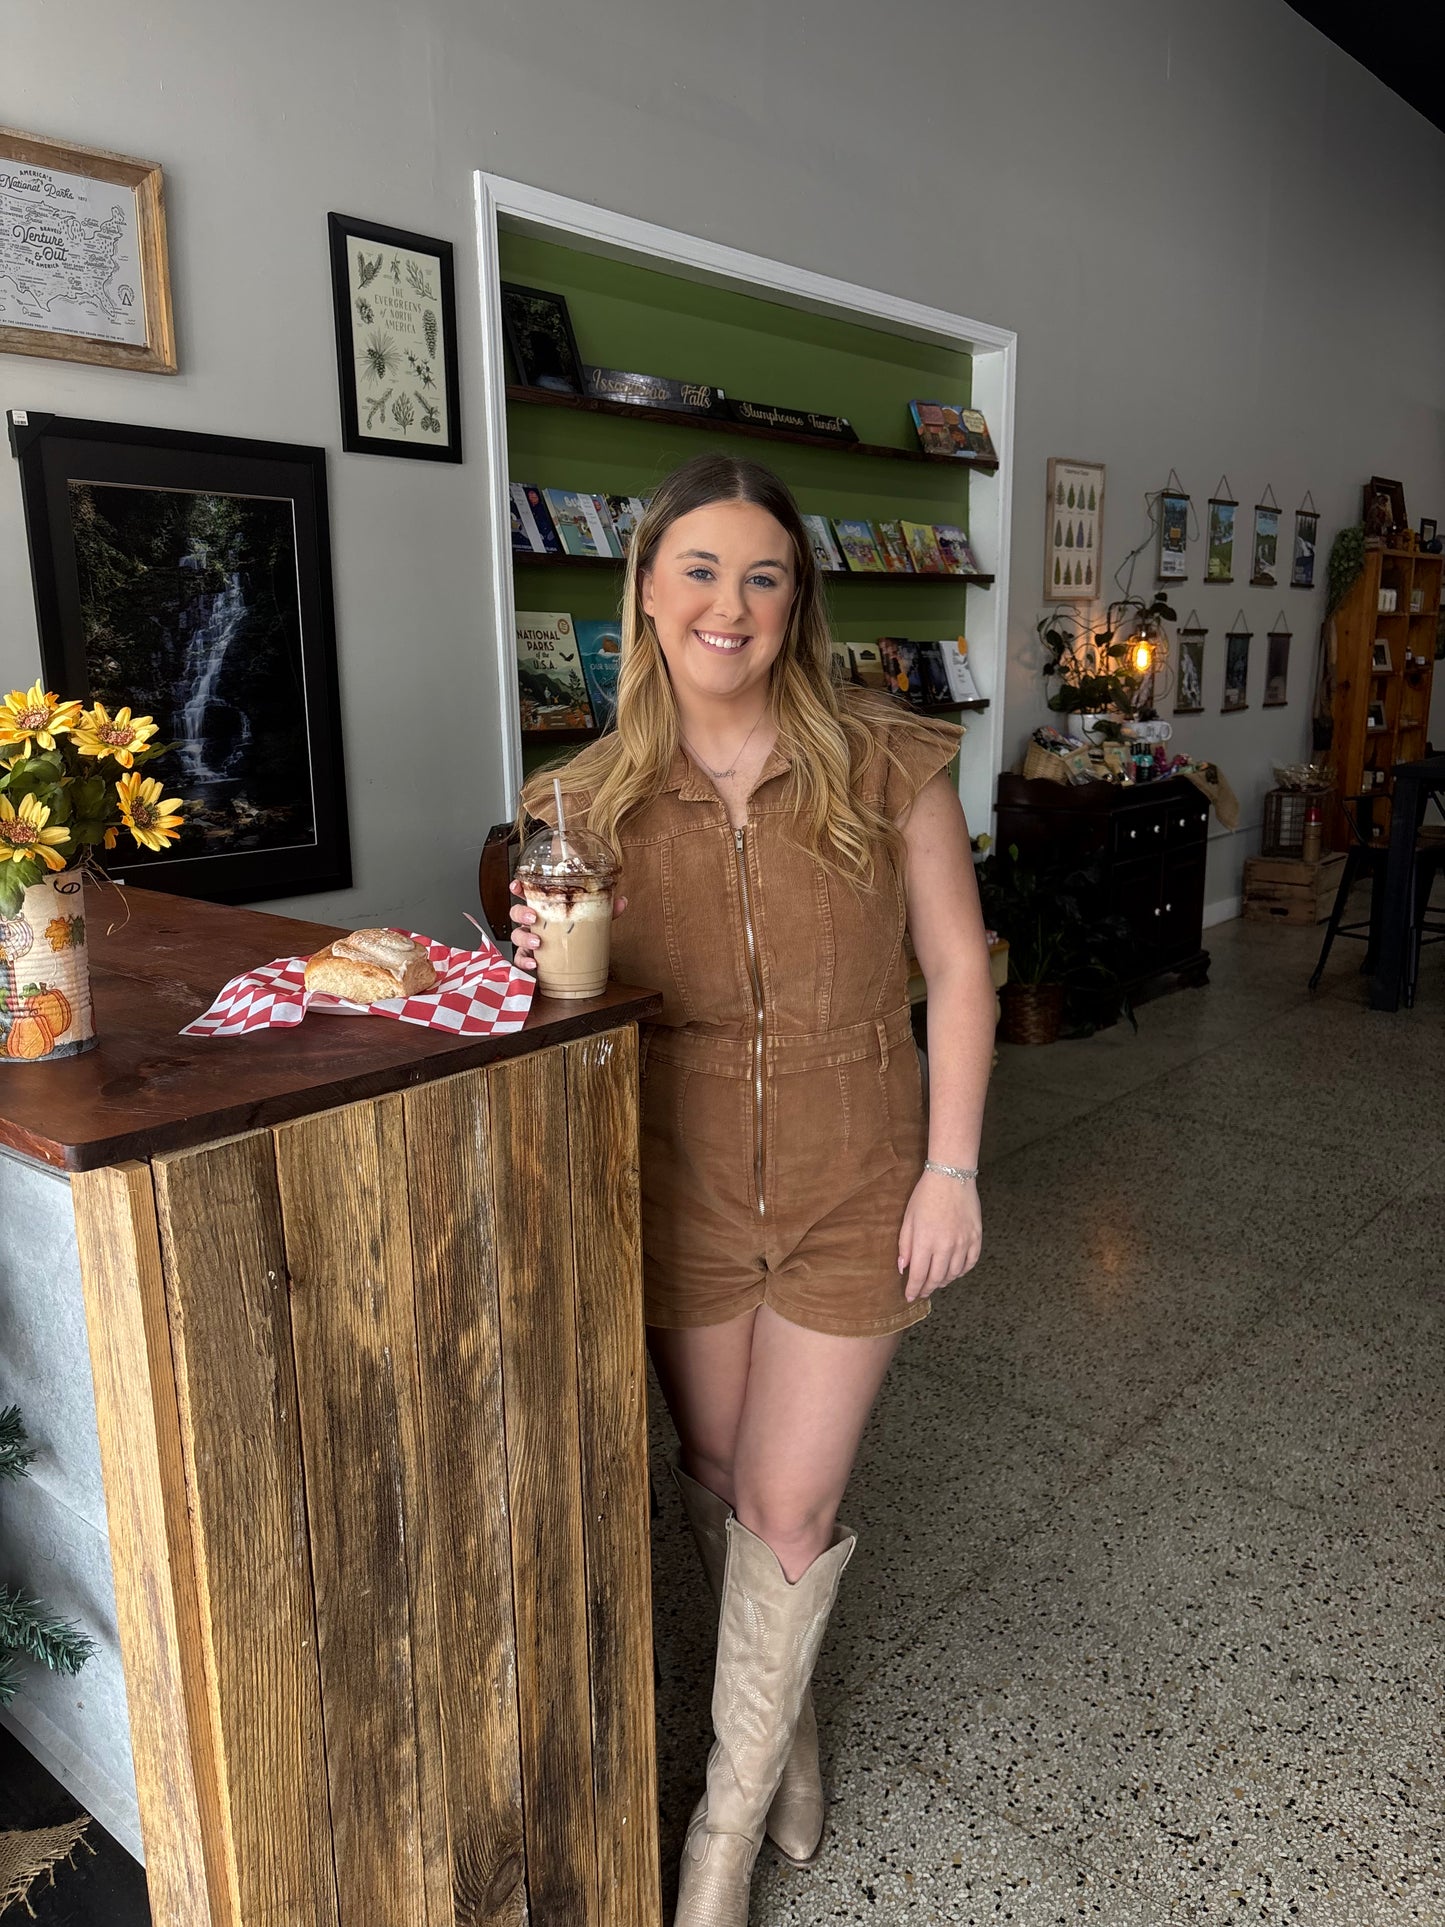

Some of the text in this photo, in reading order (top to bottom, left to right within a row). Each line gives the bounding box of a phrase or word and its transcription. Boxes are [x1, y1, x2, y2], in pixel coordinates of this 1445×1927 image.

[19, 170, 52, 182] AMERICA'S
[0, 174, 74, 200] National Parks
[12, 225, 65, 248] Venture
[39, 226, 62, 235] BRAVELY
[34, 251, 43, 261] &
[42, 246, 69, 262] Out
[24, 257, 59, 269] SEE AMERICA
[391, 286, 404, 298] THE
[374, 294, 422, 313] EVERGREENS
[390, 309, 413, 322] NORTH
[385, 319, 417, 334] AMERICA
[680, 384, 712, 409] Falls
[738, 402, 843, 432] Stumphouse Tunnel
[516, 629, 561, 641] NATIONAL
[526, 641, 555, 651] PARKS
[533, 660, 558, 670] U.S.A.
